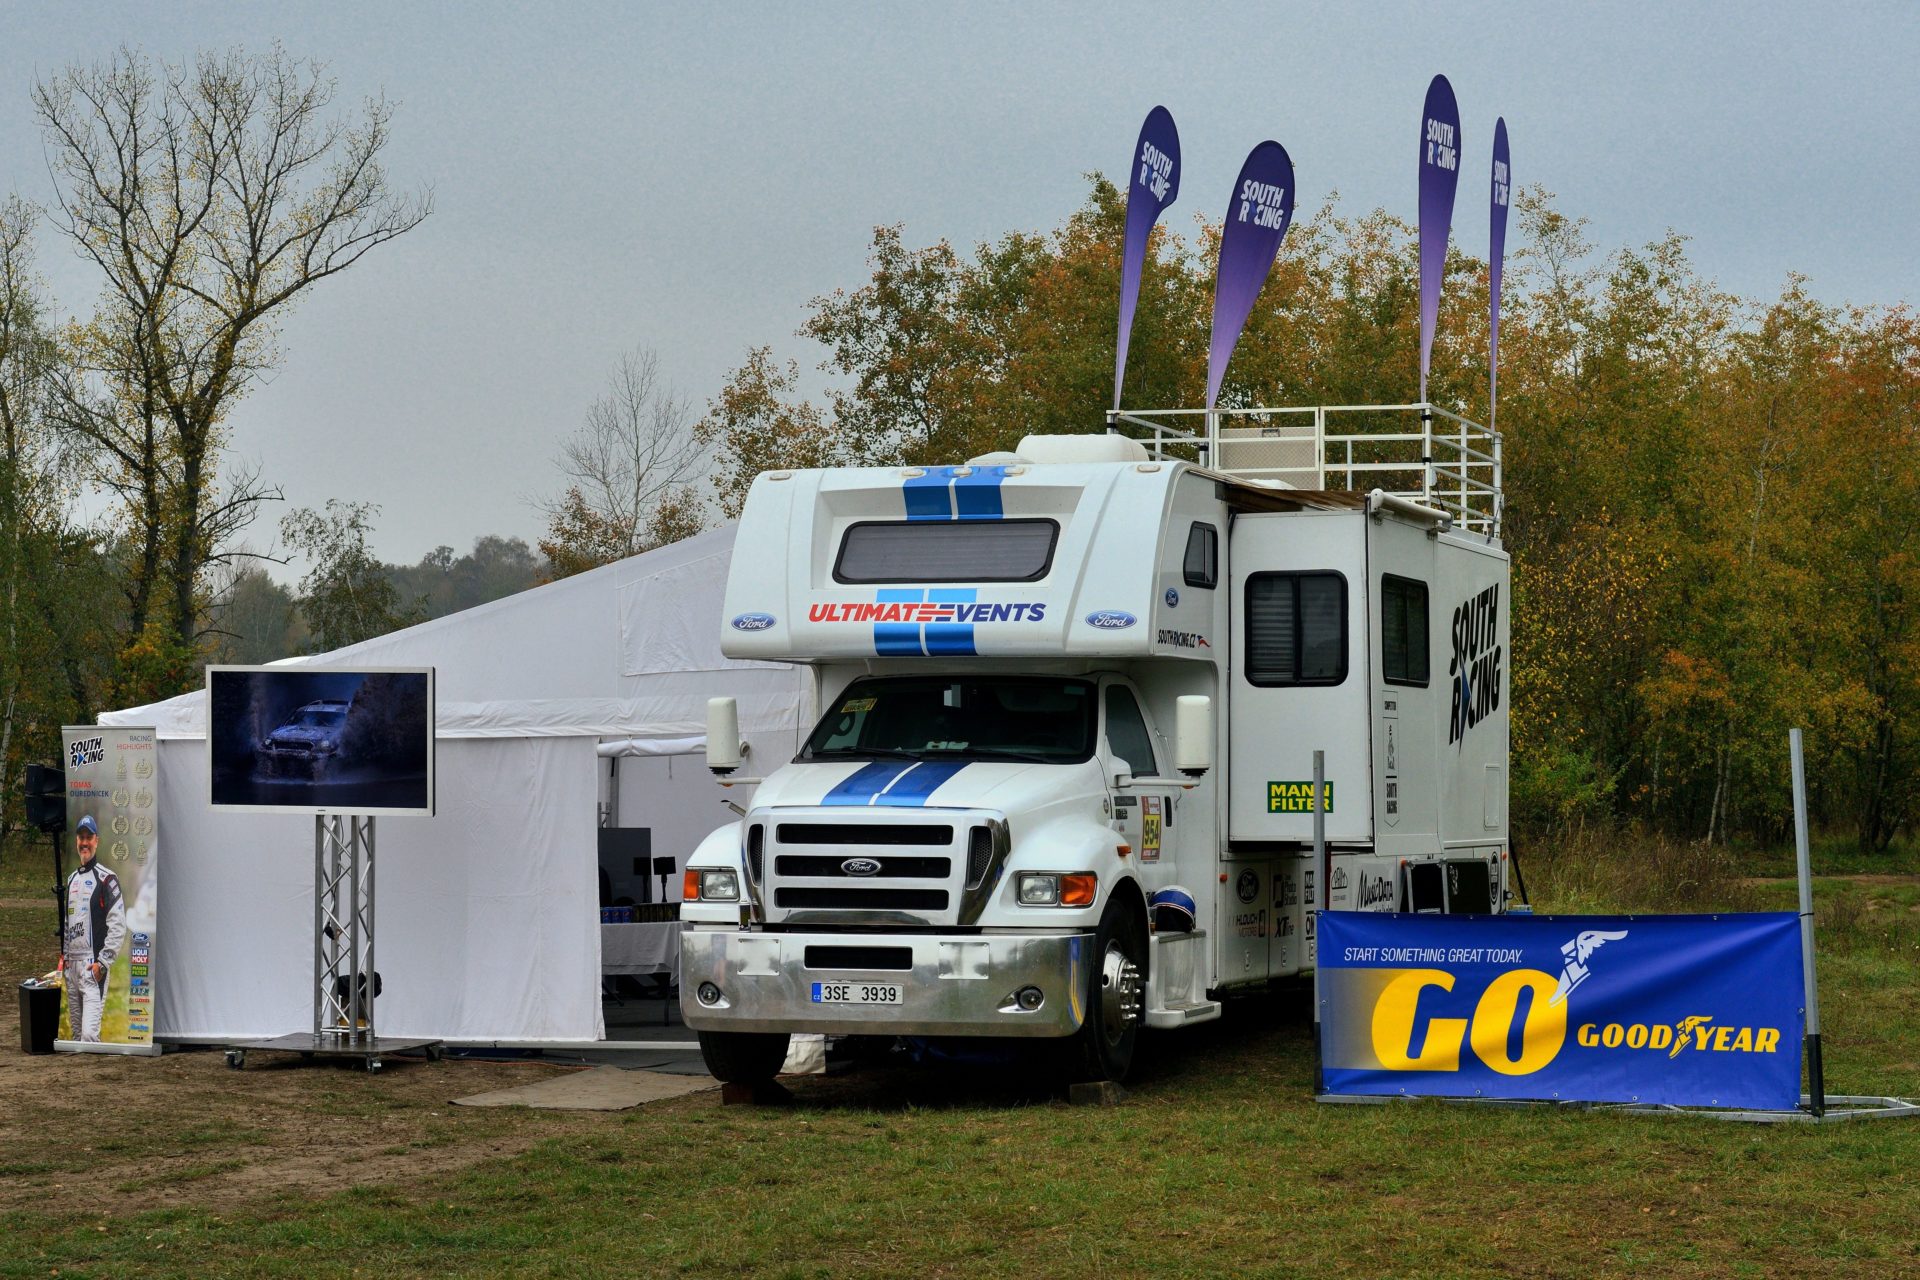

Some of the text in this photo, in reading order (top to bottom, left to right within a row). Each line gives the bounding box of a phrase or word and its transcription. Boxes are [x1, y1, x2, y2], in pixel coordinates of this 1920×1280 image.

[1427, 118, 1454, 148] SOUTH
[1141, 141, 1173, 180] SOUTH
[1240, 179, 1285, 208] SOUTH
[738, 613, 769, 630] Ford
[1093, 611, 1129, 627] Ford
[1450, 582, 1499, 677] SOUTH
[70, 736, 103, 755] SOUTH
[1144, 819, 1160, 845] 954
[848, 861, 873, 873] Ford
[1240, 872, 1256, 898] Ford
[1344, 947, 1523, 964] START SOMETHING GREAT TODAY.
[824, 985, 897, 1002] 3SE 3939
[1371, 968, 1567, 1076] GO
